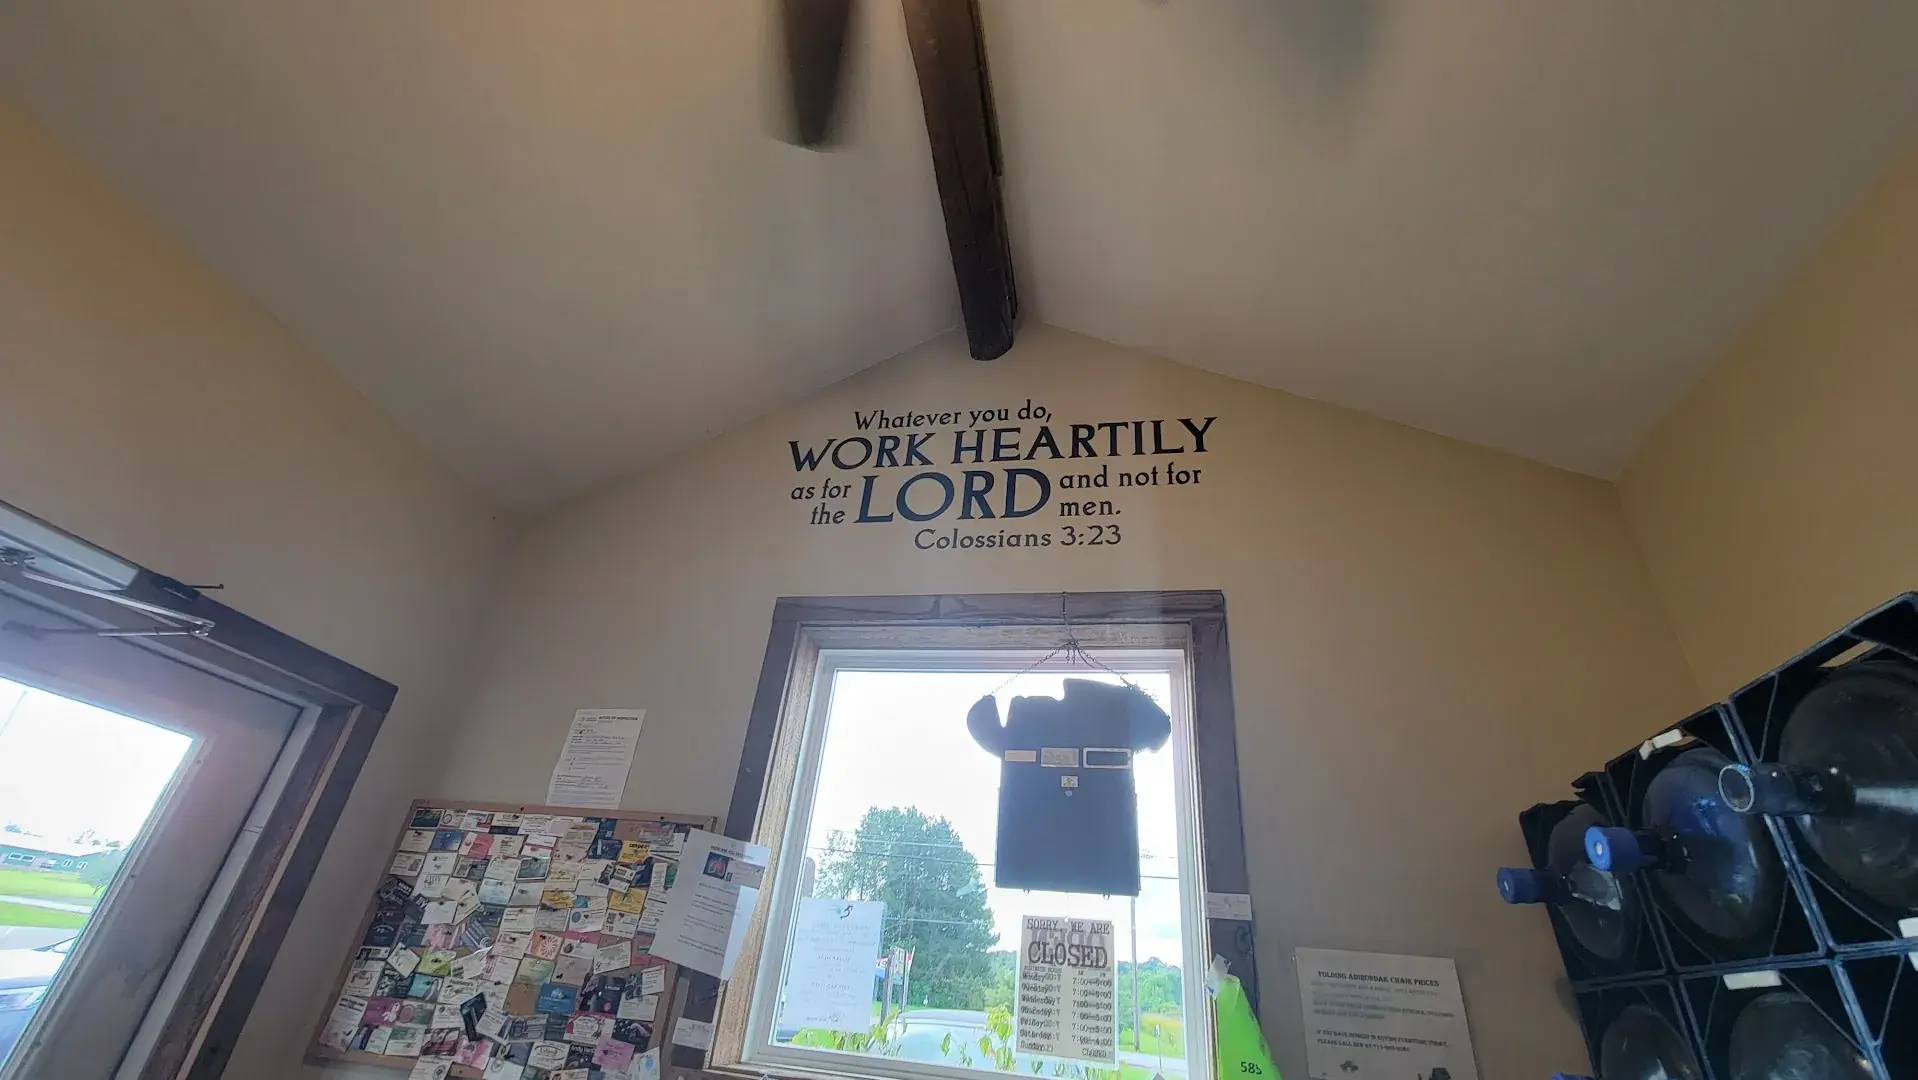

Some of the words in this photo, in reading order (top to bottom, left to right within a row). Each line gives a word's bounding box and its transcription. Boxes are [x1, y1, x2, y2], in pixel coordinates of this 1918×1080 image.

[854, 410, 961, 431] Whatever
[968, 408, 1010, 429] you
[1017, 399, 1052, 424] do,
[787, 431, 935, 472] WORK
[952, 415, 1218, 465] HEARTILY
[1059, 466, 1107, 489] and
[1119, 466, 1158, 487] not
[1168, 462, 1202, 485] for
[791, 485, 814, 501] as
[820, 477, 851, 500] for
[853, 468, 1051, 524] LORD
[811, 503, 846, 525] the
[1059, 498, 1122, 517] men.
[914, 527, 1051, 550] Colossians
[1060, 525, 1121, 547] 3:23
[1070, 921, 1084, 933] WE
[1090, 923, 1110, 935] ARE
[1028, 941, 1108, 968] CLOSED
[1318, 970, 1346, 980] FOLDING
[1390, 976, 1412, 986] CHAIR
